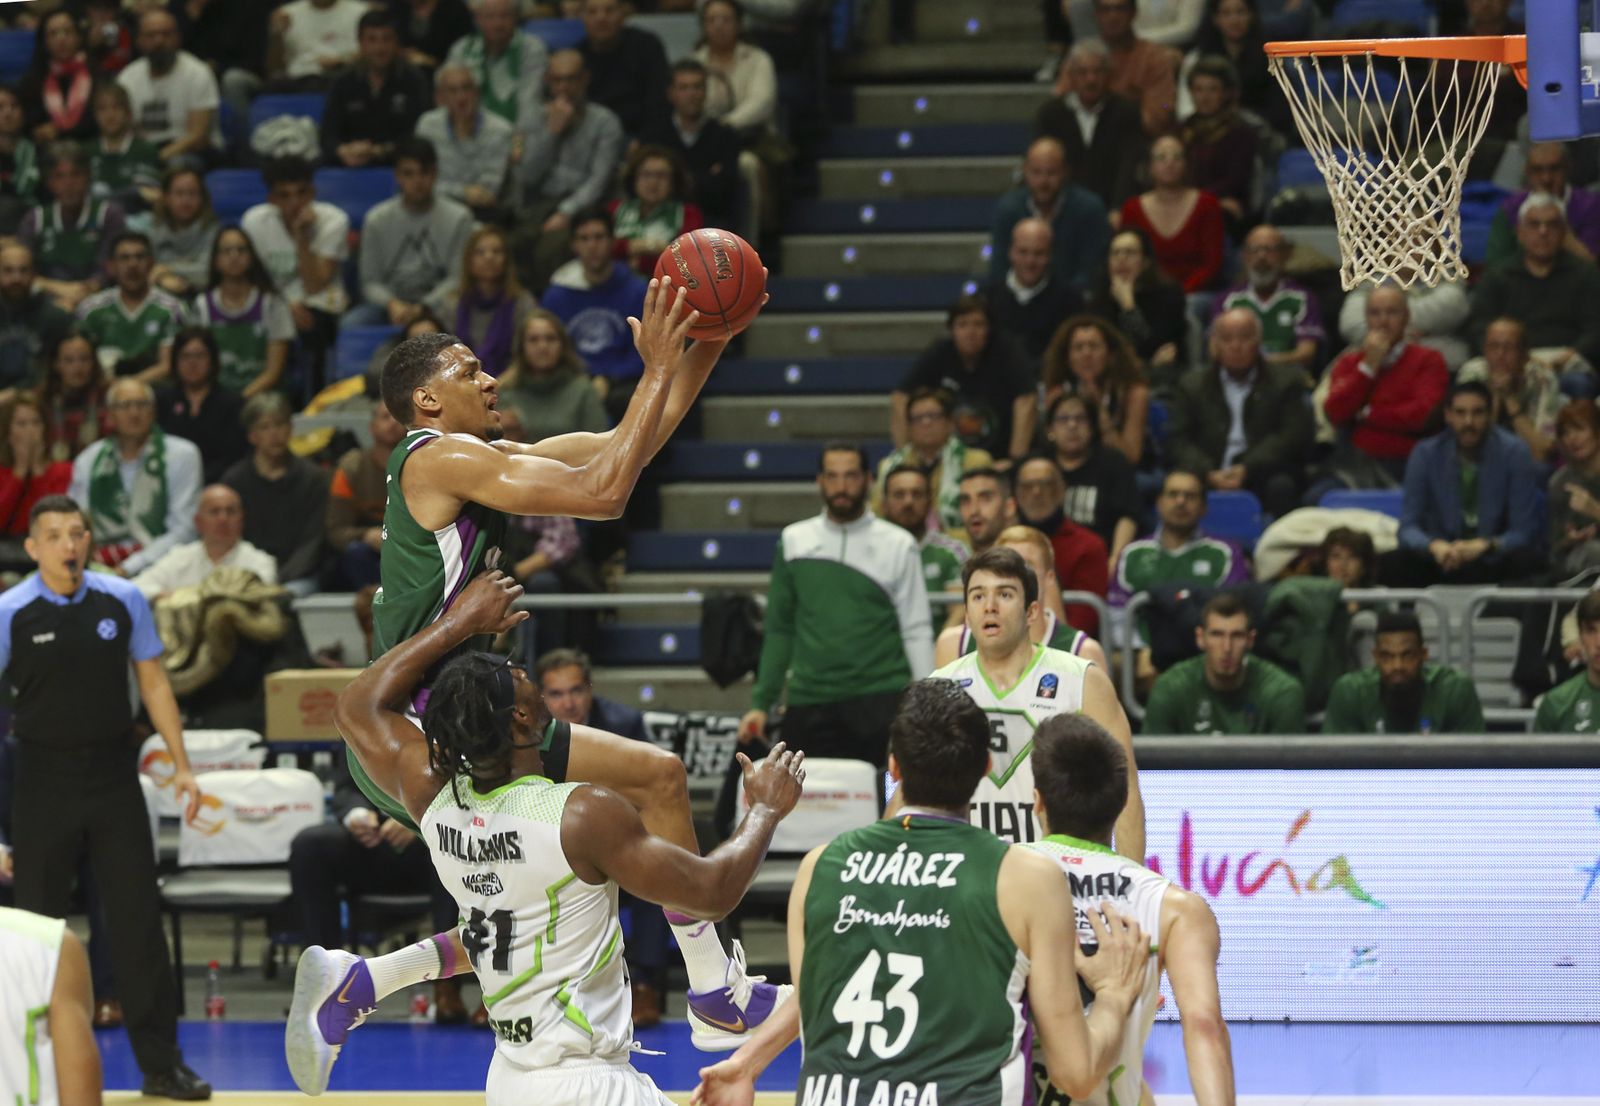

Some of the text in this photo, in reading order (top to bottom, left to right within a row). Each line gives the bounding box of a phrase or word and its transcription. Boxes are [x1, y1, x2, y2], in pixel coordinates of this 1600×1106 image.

[436, 823, 522, 863] WILLIAMS
[968, 801, 1035, 844] IAT
[840, 842, 965, 888] SUÁREZ
[1063, 871, 1132, 901] MAZ
[462, 906, 514, 971] 41
[832, 949, 924, 1059] 43
